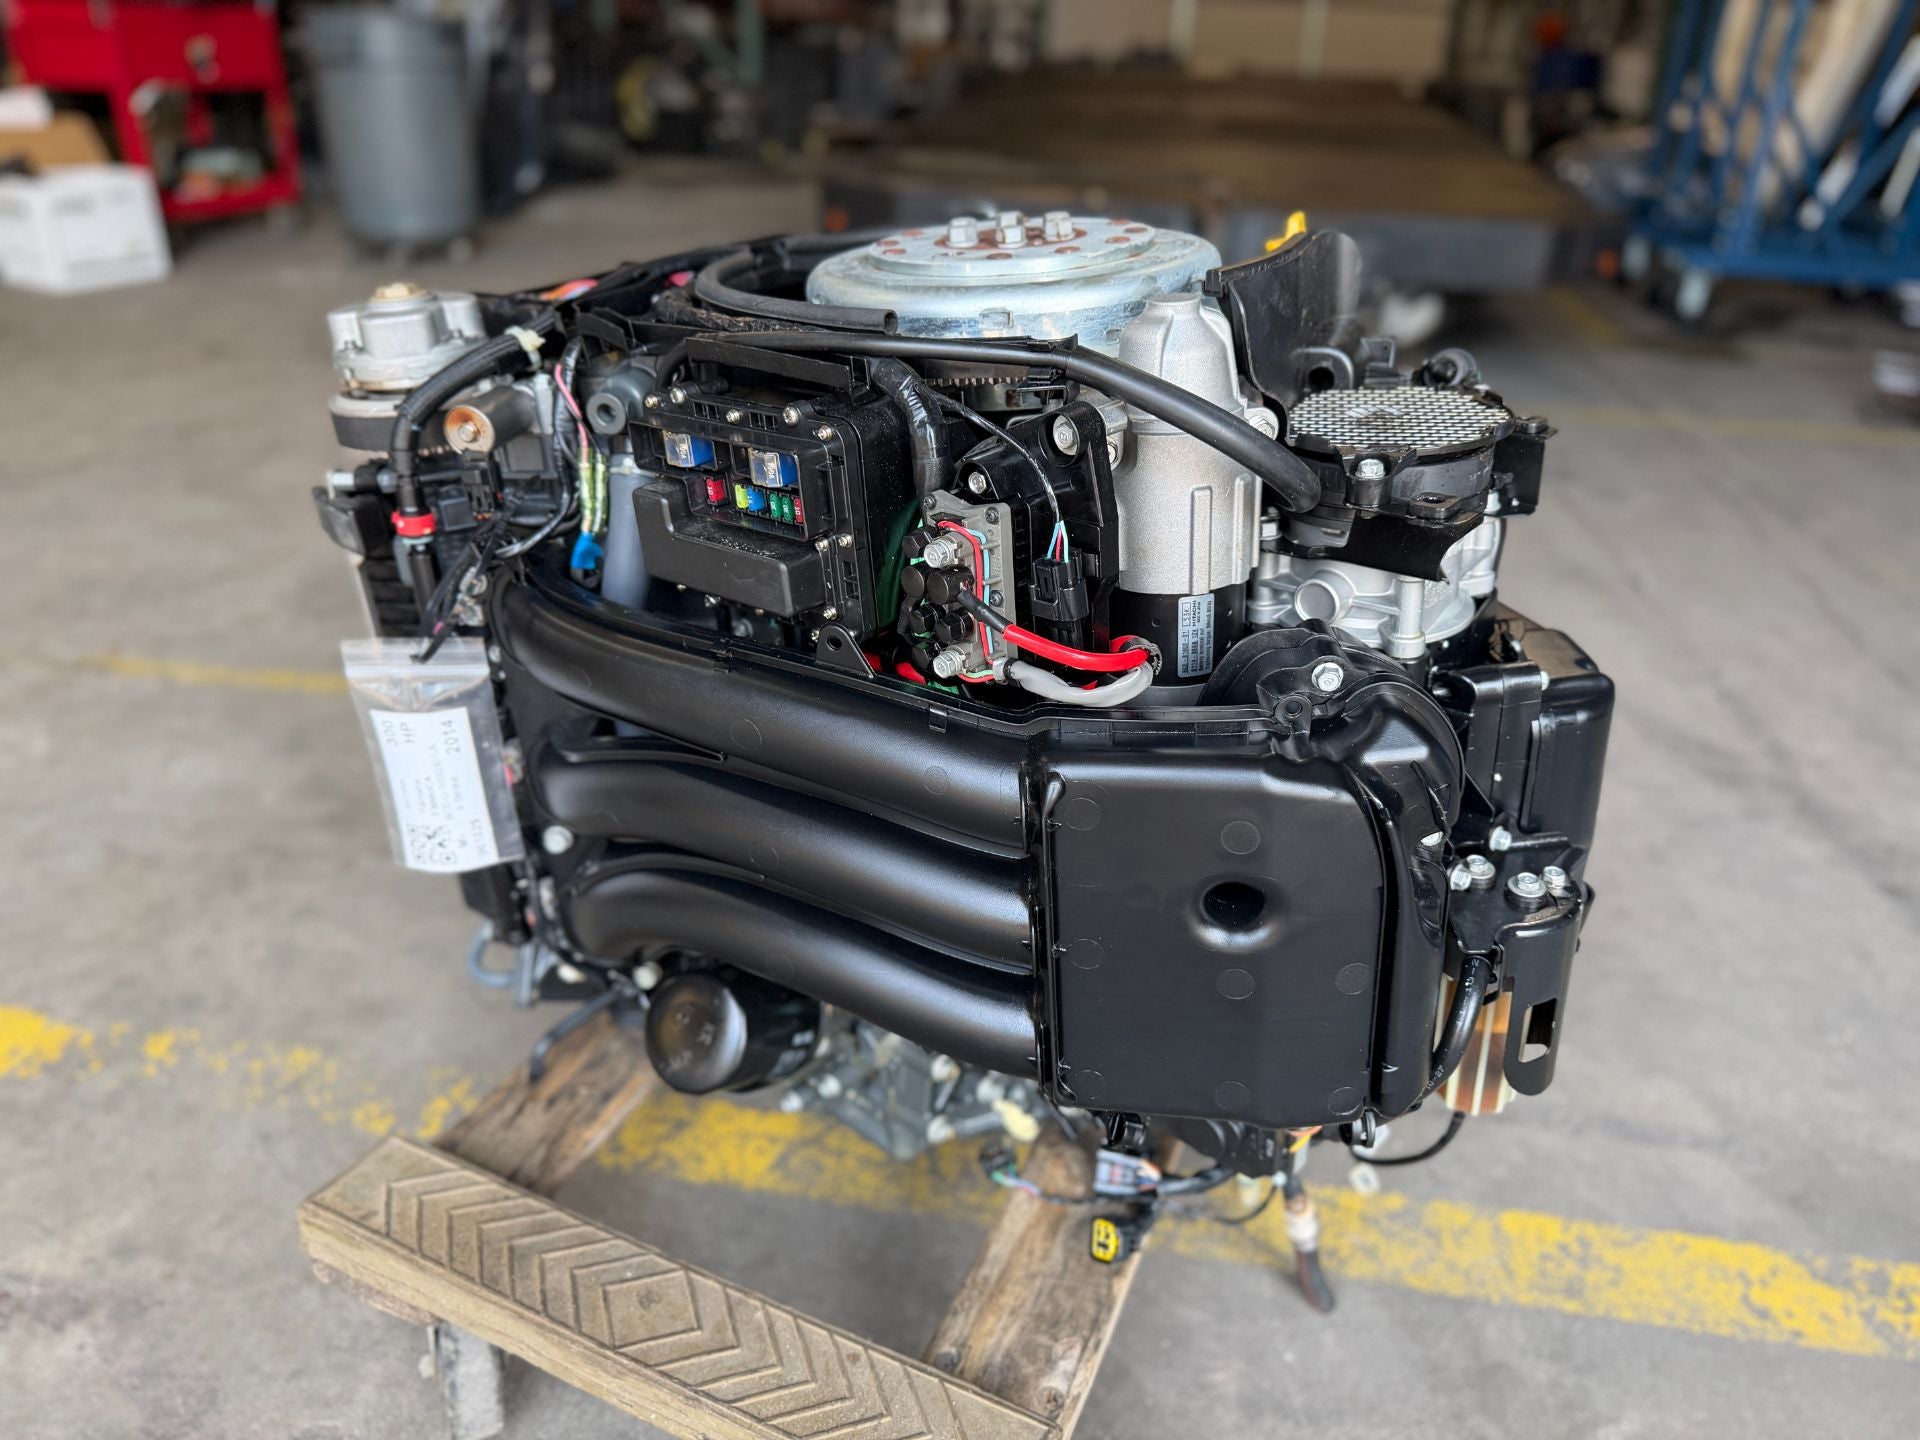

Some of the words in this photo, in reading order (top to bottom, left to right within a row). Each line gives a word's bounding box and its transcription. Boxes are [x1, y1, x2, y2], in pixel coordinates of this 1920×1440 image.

[767, 462, 775, 480] 100A
[707, 486, 713, 496] 10
[794, 506, 800, 516] 10
[400, 722, 416, 744] HP
[440, 719, 461, 755] 2014
